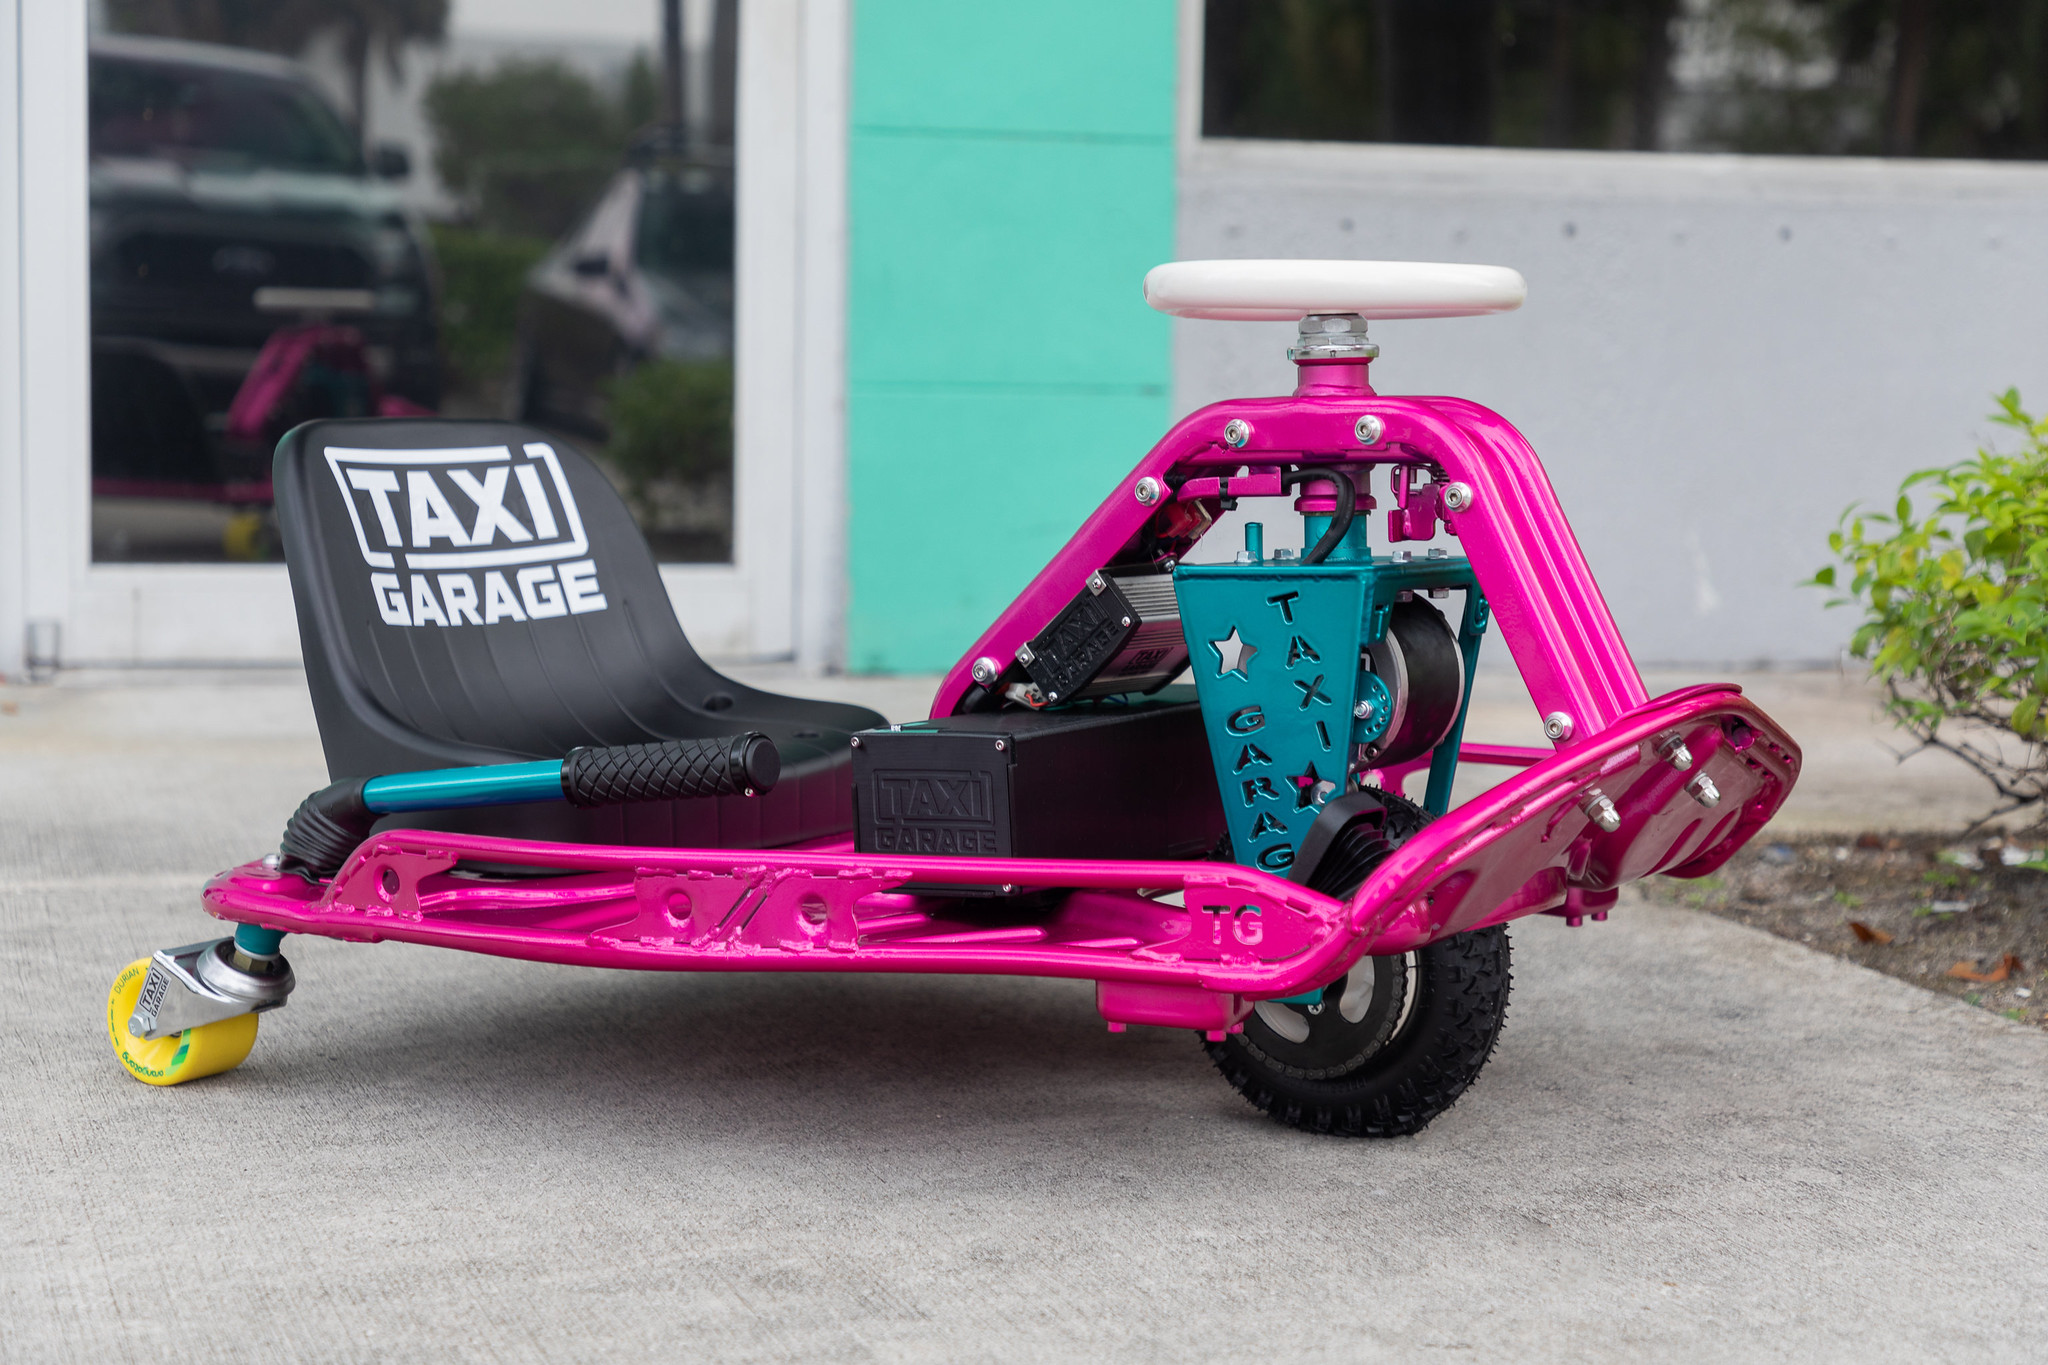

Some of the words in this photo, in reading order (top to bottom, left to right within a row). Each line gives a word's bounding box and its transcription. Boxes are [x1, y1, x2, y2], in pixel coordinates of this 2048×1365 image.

[346, 464, 559, 547] TAXI
[371, 559, 608, 627] GARAGE
[1041, 603, 1099, 668] TAXI
[1266, 590, 1332, 752] TAXI
[881, 778, 983, 817] TAXI
[1226, 705, 1296, 873] GARAG
[875, 827, 997, 853] GARAGE
[1202, 904, 1263, 946] TG
[113, 967, 139, 994] DURIAN
[141, 971, 161, 1006] TAXI
[151, 977, 169, 1018] GARAGE
